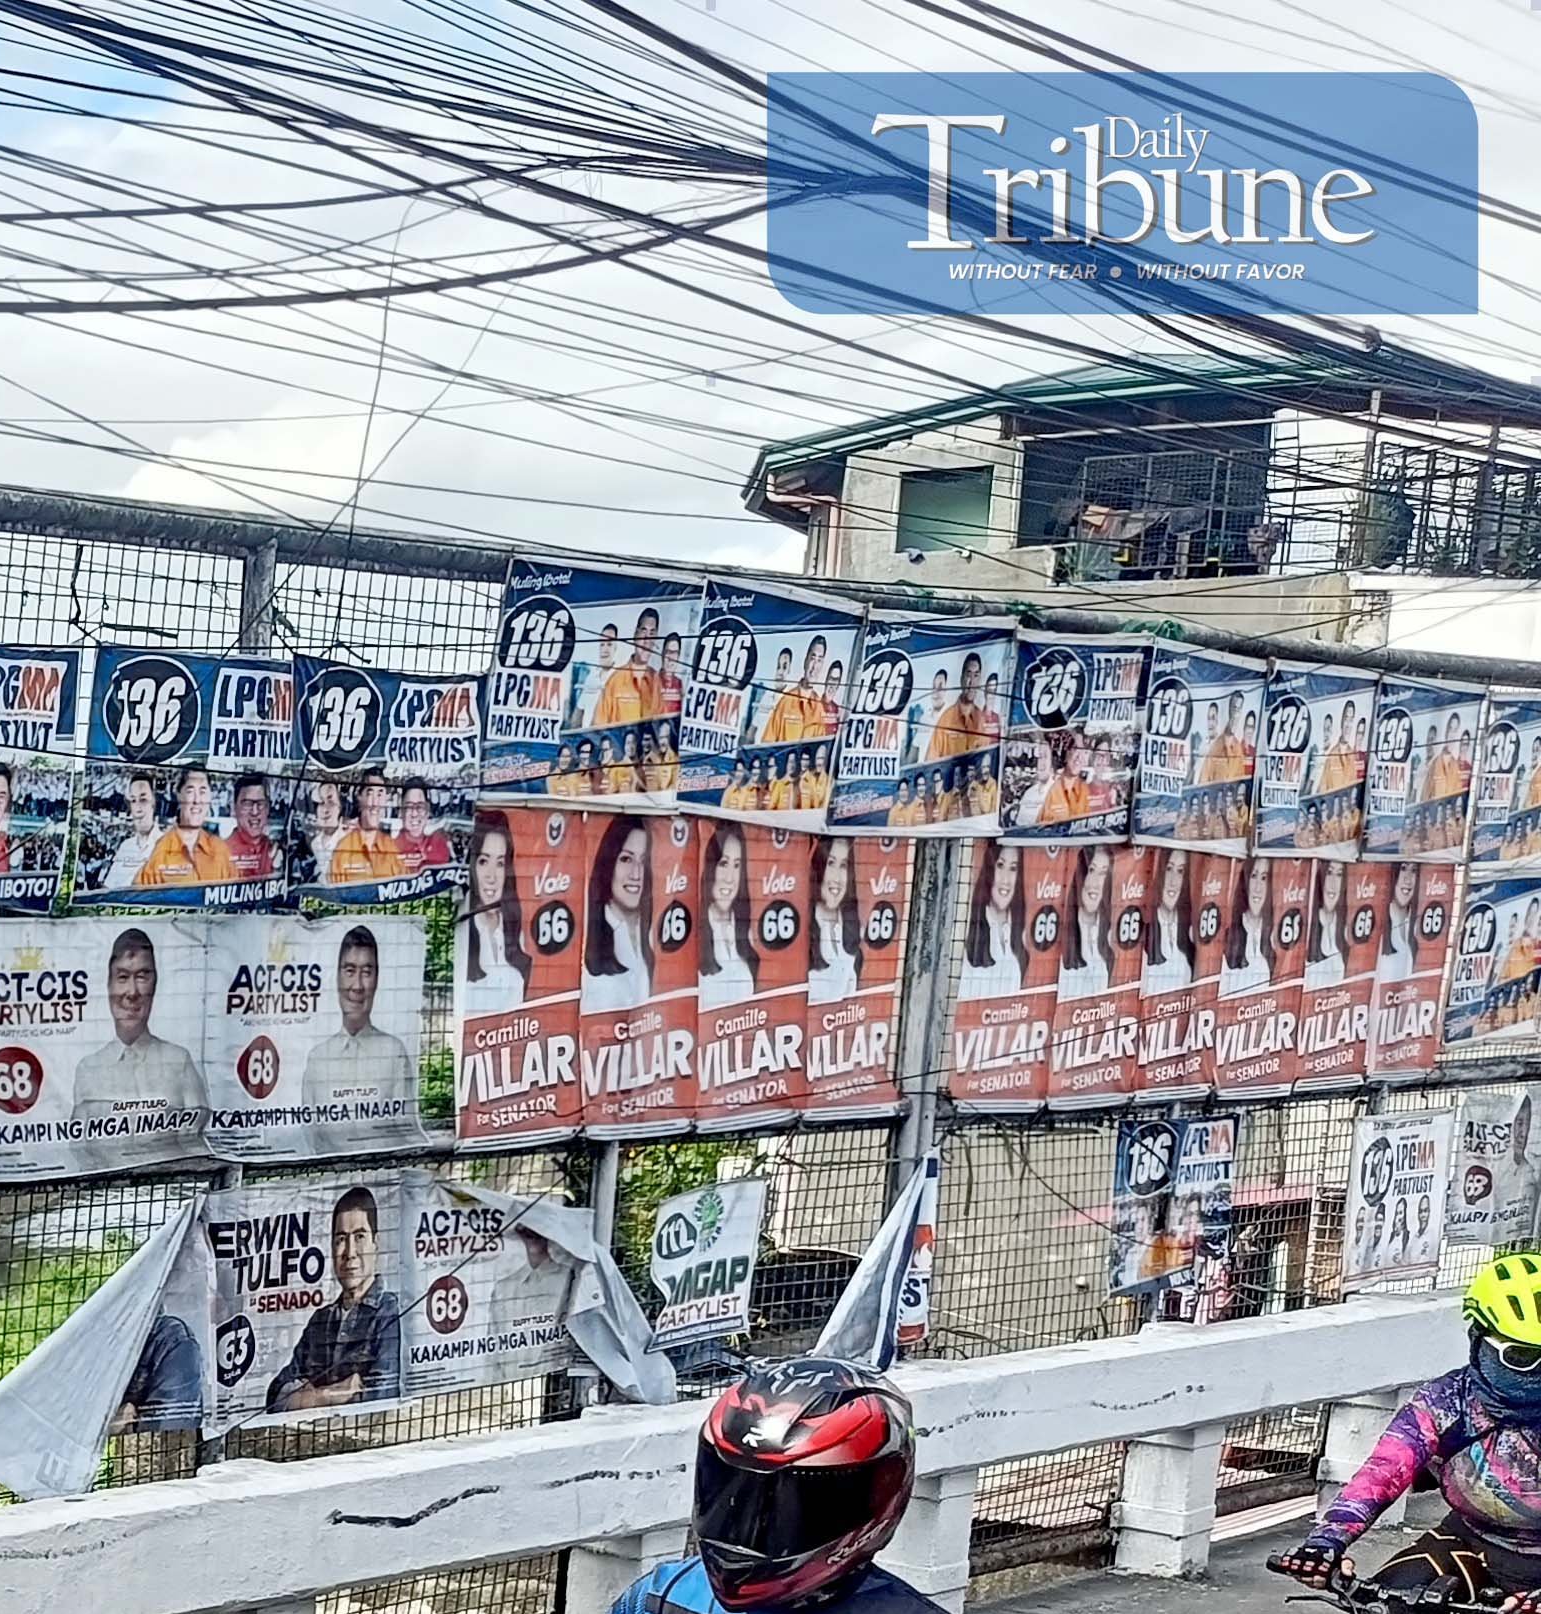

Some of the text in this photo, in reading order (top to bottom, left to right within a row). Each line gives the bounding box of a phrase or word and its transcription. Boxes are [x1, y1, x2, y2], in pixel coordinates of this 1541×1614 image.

[508, 612, 565, 666] 136
[493, 673, 561, 712] LPGMA
[204, 883, 260, 905] MULING
[762, 863, 796, 896] Vote
[1036, 875, 1062, 900] Vote
[1121, 875, 1145, 899] Vote
[762, 909, 796, 943] 66
[866, 909, 895, 940] 66
[1034, 915, 1056, 940] 66
[1119, 912, 1141, 939] 66
[229, 964, 322, 993] ACT-CIS
[715, 1008, 767, 1038] Camille
[981, 1003, 1028, 1026] Camille
[1072, 1000, 1117, 1025] Camille
[474, 1017, 540, 1050] Camille
[1053, 1017, 1138, 1074] VILLAR
[954, 1022, 1048, 1075] VILLAR
[979, 1071, 1032, 1095] SENATOR
[1072, 1066, 1122, 1091] SENATOR
[725, 1079, 787, 1108] SENATOR
[416, 1207, 505, 1238] ACT-CIS
[233, 1248, 324, 1295] TULFO
[257, 1289, 322, 1314] SENADO
